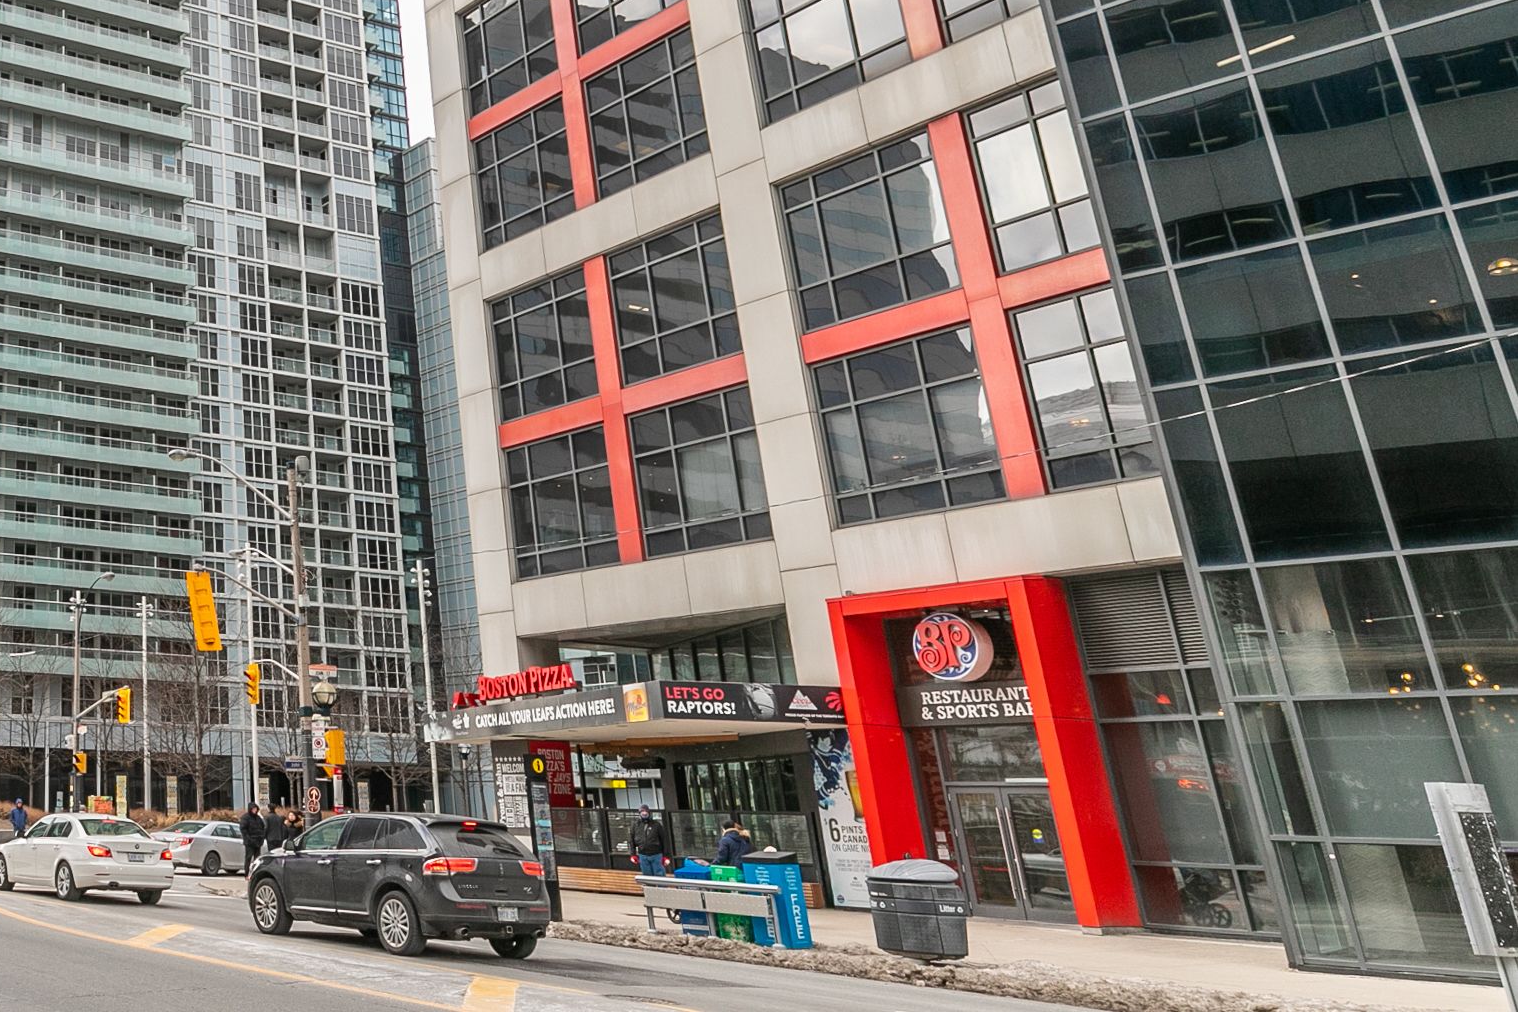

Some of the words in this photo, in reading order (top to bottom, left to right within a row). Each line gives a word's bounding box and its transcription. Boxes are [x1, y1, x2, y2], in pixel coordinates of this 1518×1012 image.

[478, 671, 528, 701] BOSTON
[665, 686, 700, 700] LET'S
[703, 687, 725, 701] GO
[921, 686, 1031, 705] RESTAURANT
[475, 713, 497, 728] CATCH
[498, 712, 511, 726] ALL
[510, 708, 532, 724] YOUR
[532, 706, 555, 723] LEAFS
[555, 701, 587, 720] ACTION
[587, 697, 616, 717] HERE!
[667, 700, 737, 715] RAPTORS!
[922, 706, 934, 720] &
[937, 703, 999, 720] SPORTS
[502, 763, 525, 773] WELCOM
[545, 760, 566, 772] ZZA'S
[555, 772, 572, 783] JAYS
[553, 783, 573, 795] ZONE
[841, 825, 863, 834] PINTS
[842, 834, 868, 844] CANAD
[832, 844, 842, 852] ON
[842, 844, 860, 853] GAME
[860, 844, 869, 853] NI
[938, 904, 956, 913] Litter
[790, 893, 806, 940] FREE
